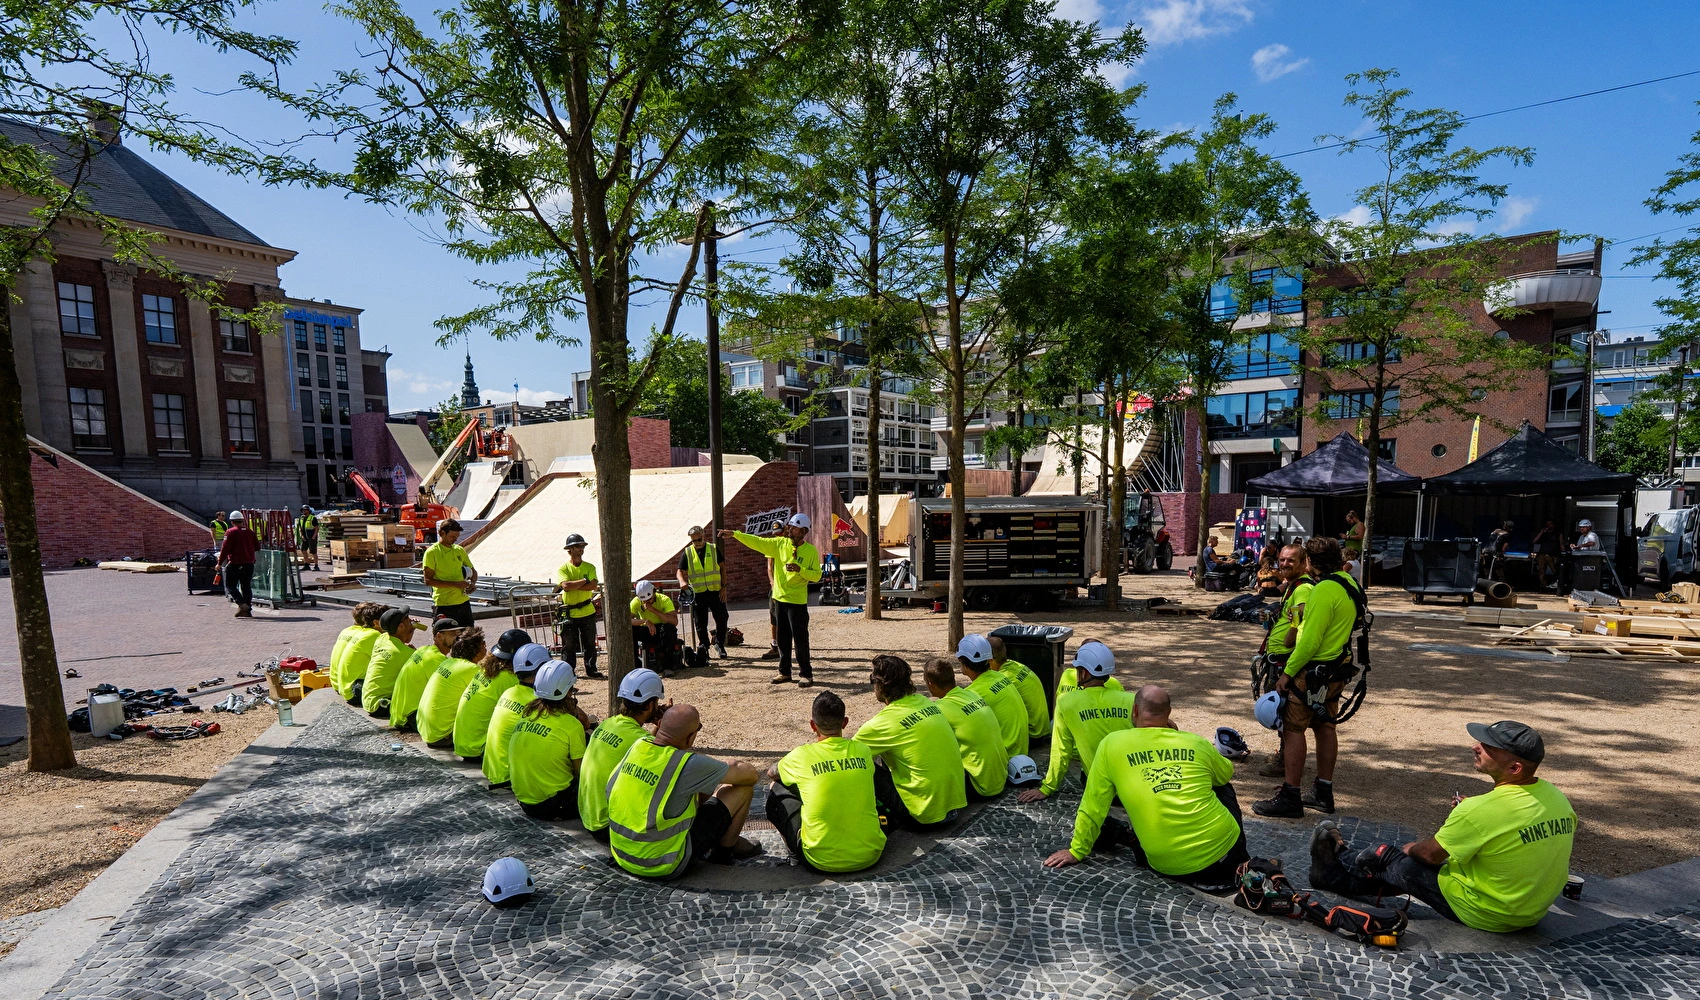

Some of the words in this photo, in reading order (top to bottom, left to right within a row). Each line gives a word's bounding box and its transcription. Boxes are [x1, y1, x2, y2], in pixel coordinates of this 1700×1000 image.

[748, 510, 788, 525] MASTERS
[747, 524, 758, 532] OF
[989, 681, 1006, 695] NINE
[503, 699, 525, 715] YARDS
[961, 701, 980, 716] NINE
[1079, 708, 1100, 722] NINE
[1100, 707, 1128, 719] YARDS
[524, 721, 552, 738] YARDS
[900, 713, 924, 730] NINE
[599, 730, 623, 749] YARDS
[1126, 750, 1155, 767] NINE
[1156, 748, 1195, 762] YARDS
[811, 760, 837, 777] NINE
[836, 757, 867, 771] YARDS
[633, 765, 659, 787] YARDS
[1518, 822, 1549, 845] NINE
